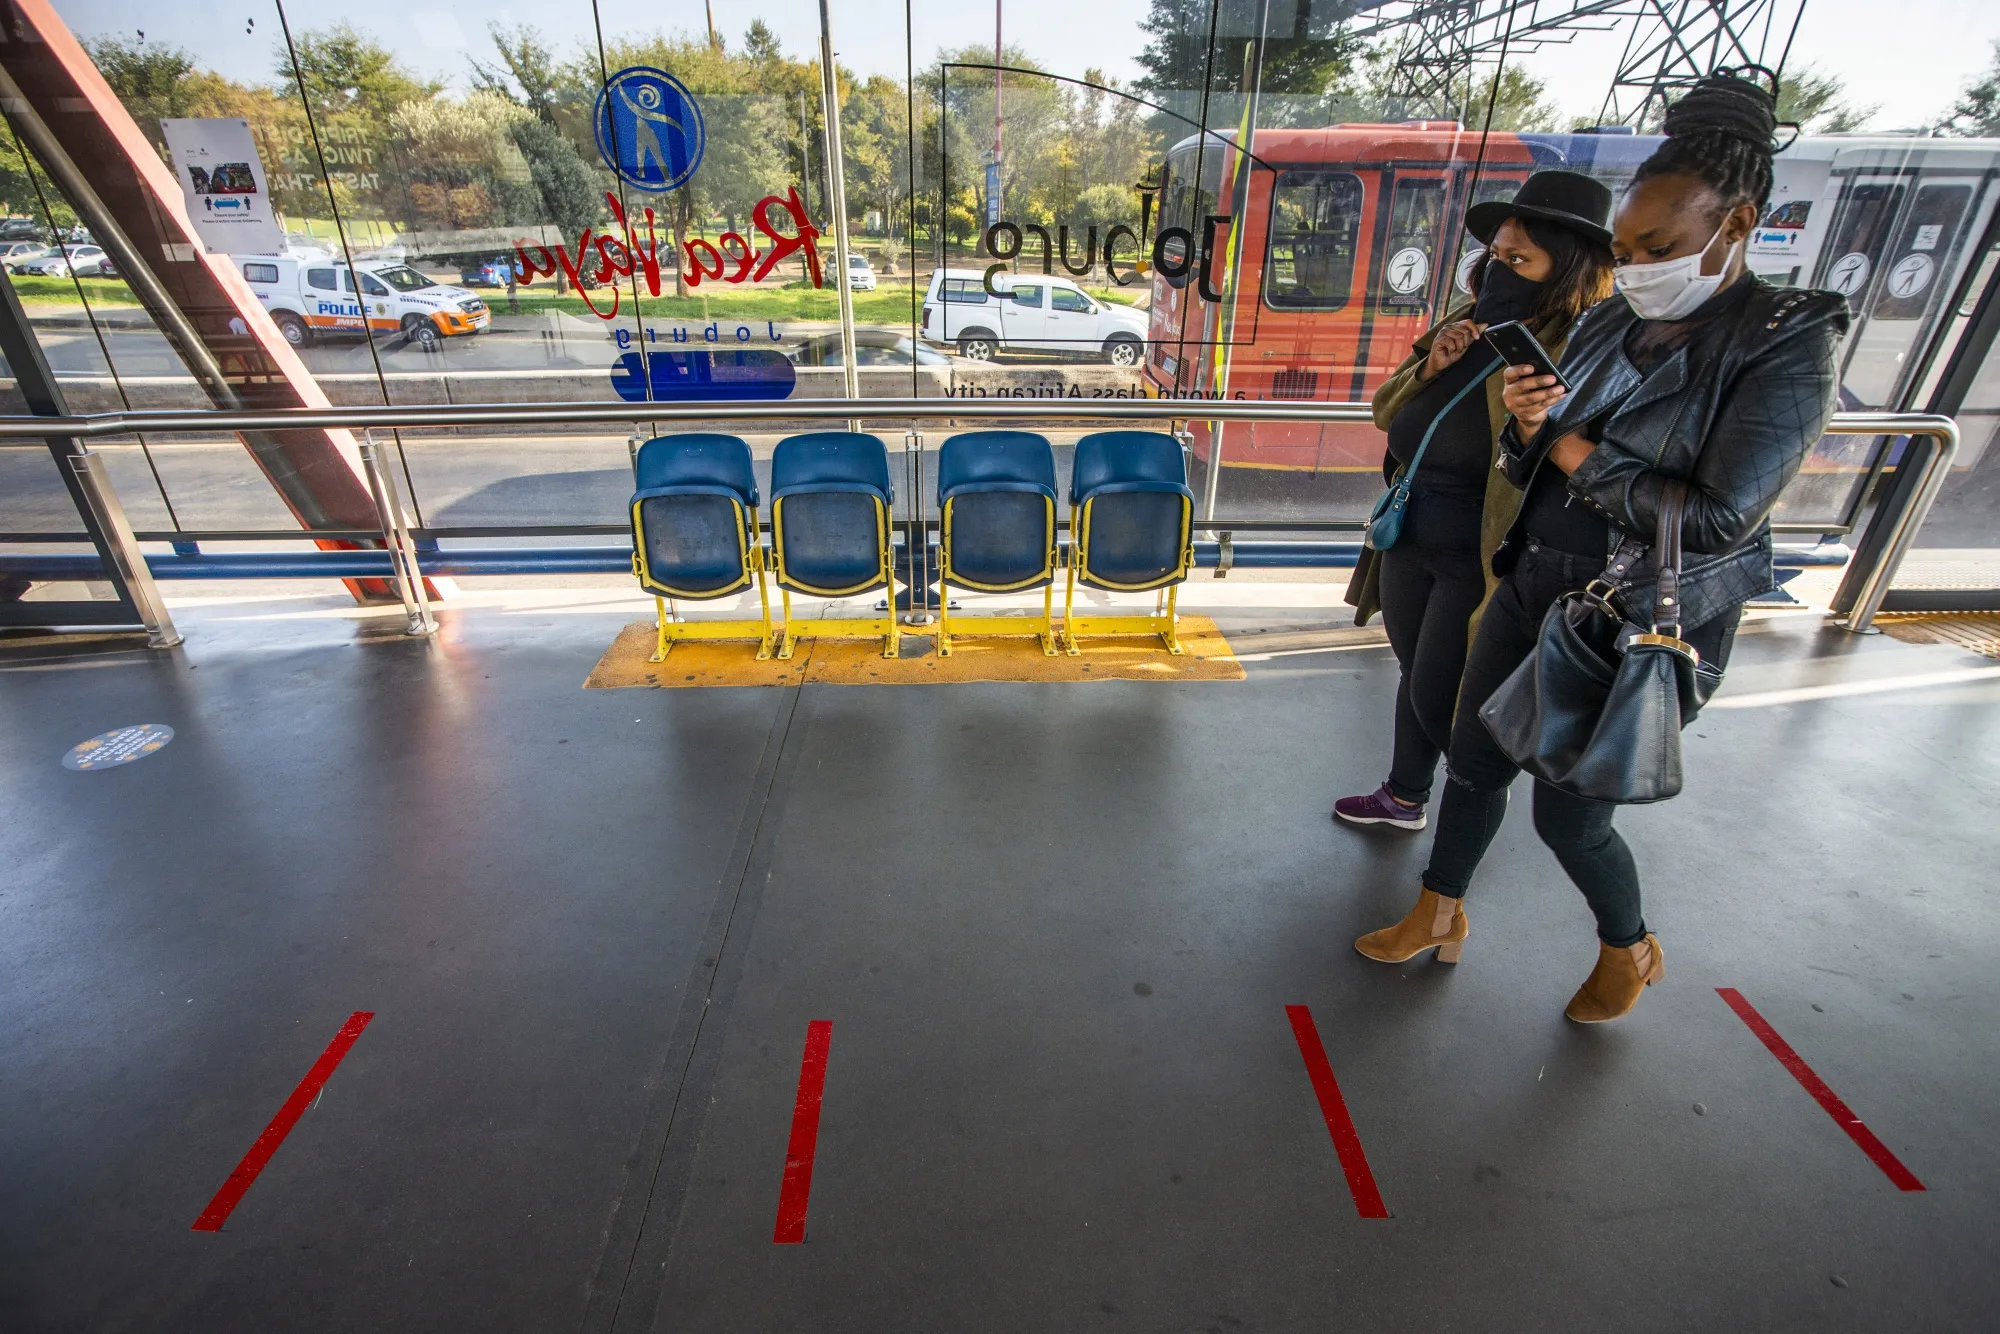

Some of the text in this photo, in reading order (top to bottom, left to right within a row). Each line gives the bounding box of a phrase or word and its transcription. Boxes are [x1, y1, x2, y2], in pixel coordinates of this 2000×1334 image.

[318, 304, 372, 317] POLICE
[77, 728, 136, 764] SAVE LIVES
